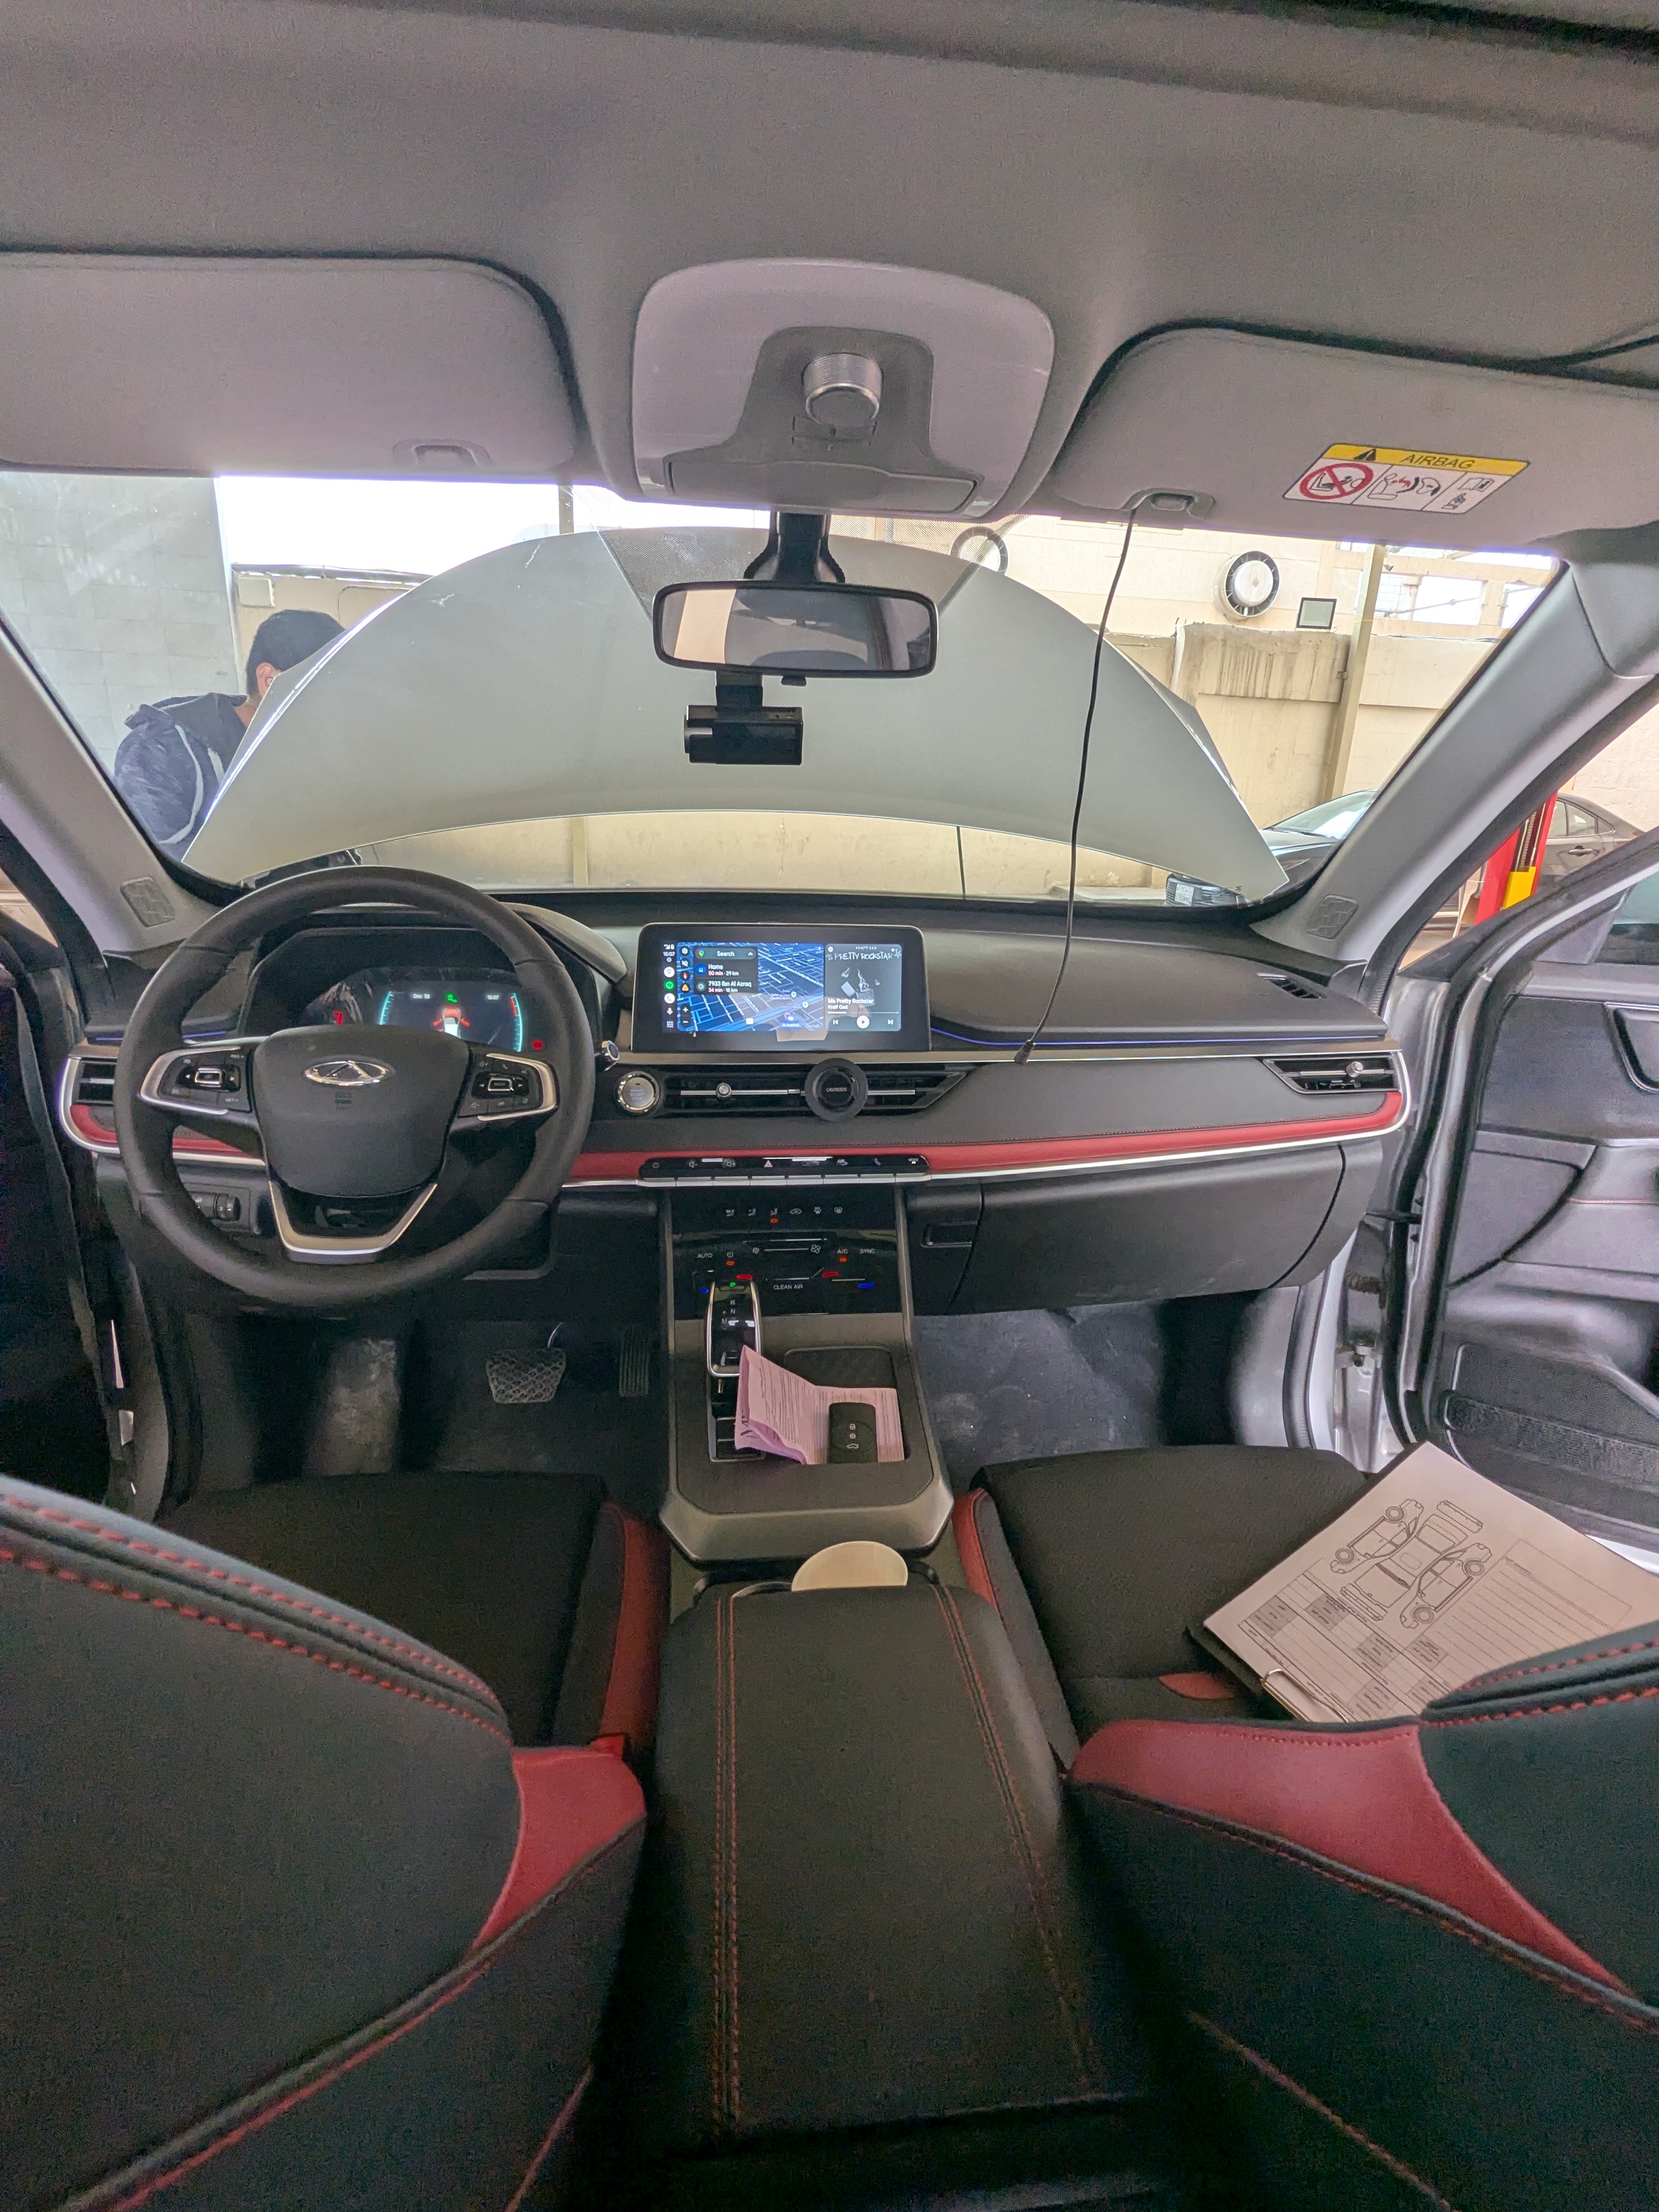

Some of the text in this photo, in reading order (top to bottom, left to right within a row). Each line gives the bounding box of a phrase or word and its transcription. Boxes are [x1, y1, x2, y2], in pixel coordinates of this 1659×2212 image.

[1400, 454, 1475, 469] AIRBAG
[834, 952, 859, 960] PRETTY
[860, 951, 893, 960] ROCKSTAR
